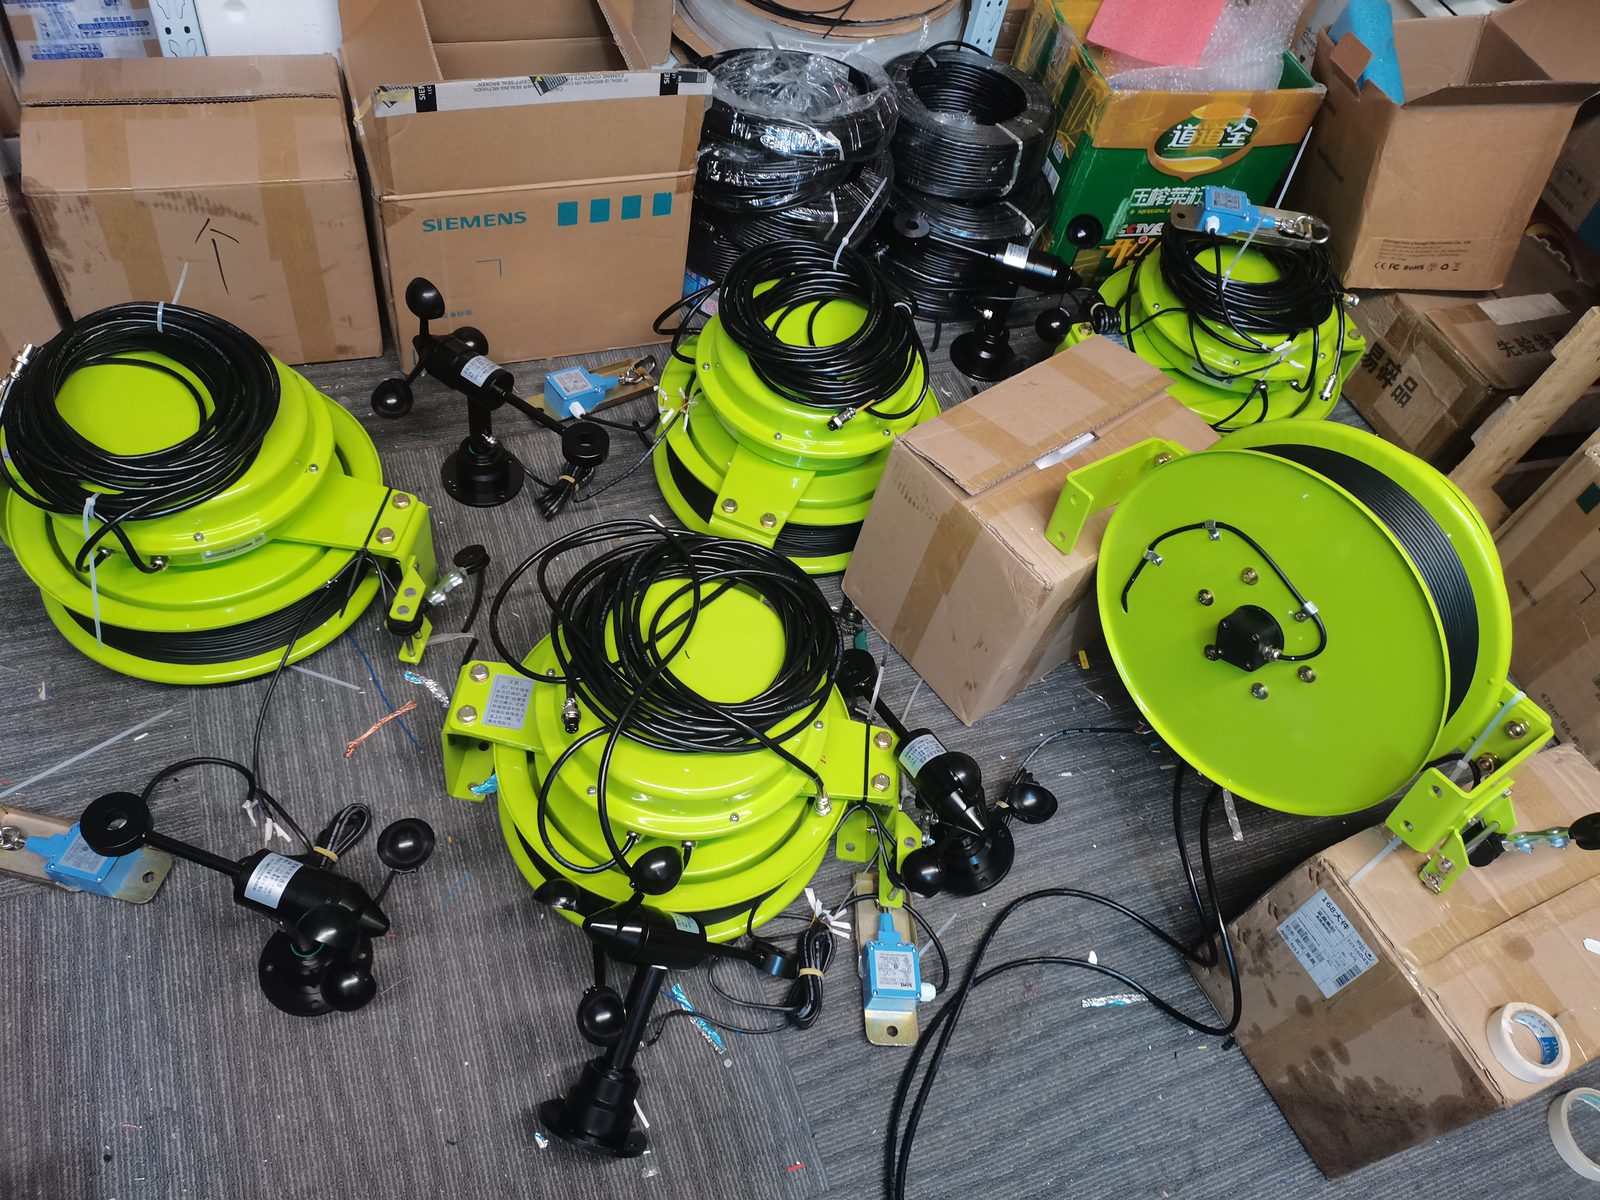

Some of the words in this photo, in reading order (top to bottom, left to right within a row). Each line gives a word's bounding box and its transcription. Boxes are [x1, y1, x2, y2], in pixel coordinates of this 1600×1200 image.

[1167, 119, 1253, 148] 道道全
[1130, 186, 1206, 207] 压榨菜籽
[422, 211, 528, 232] SIEMENS
